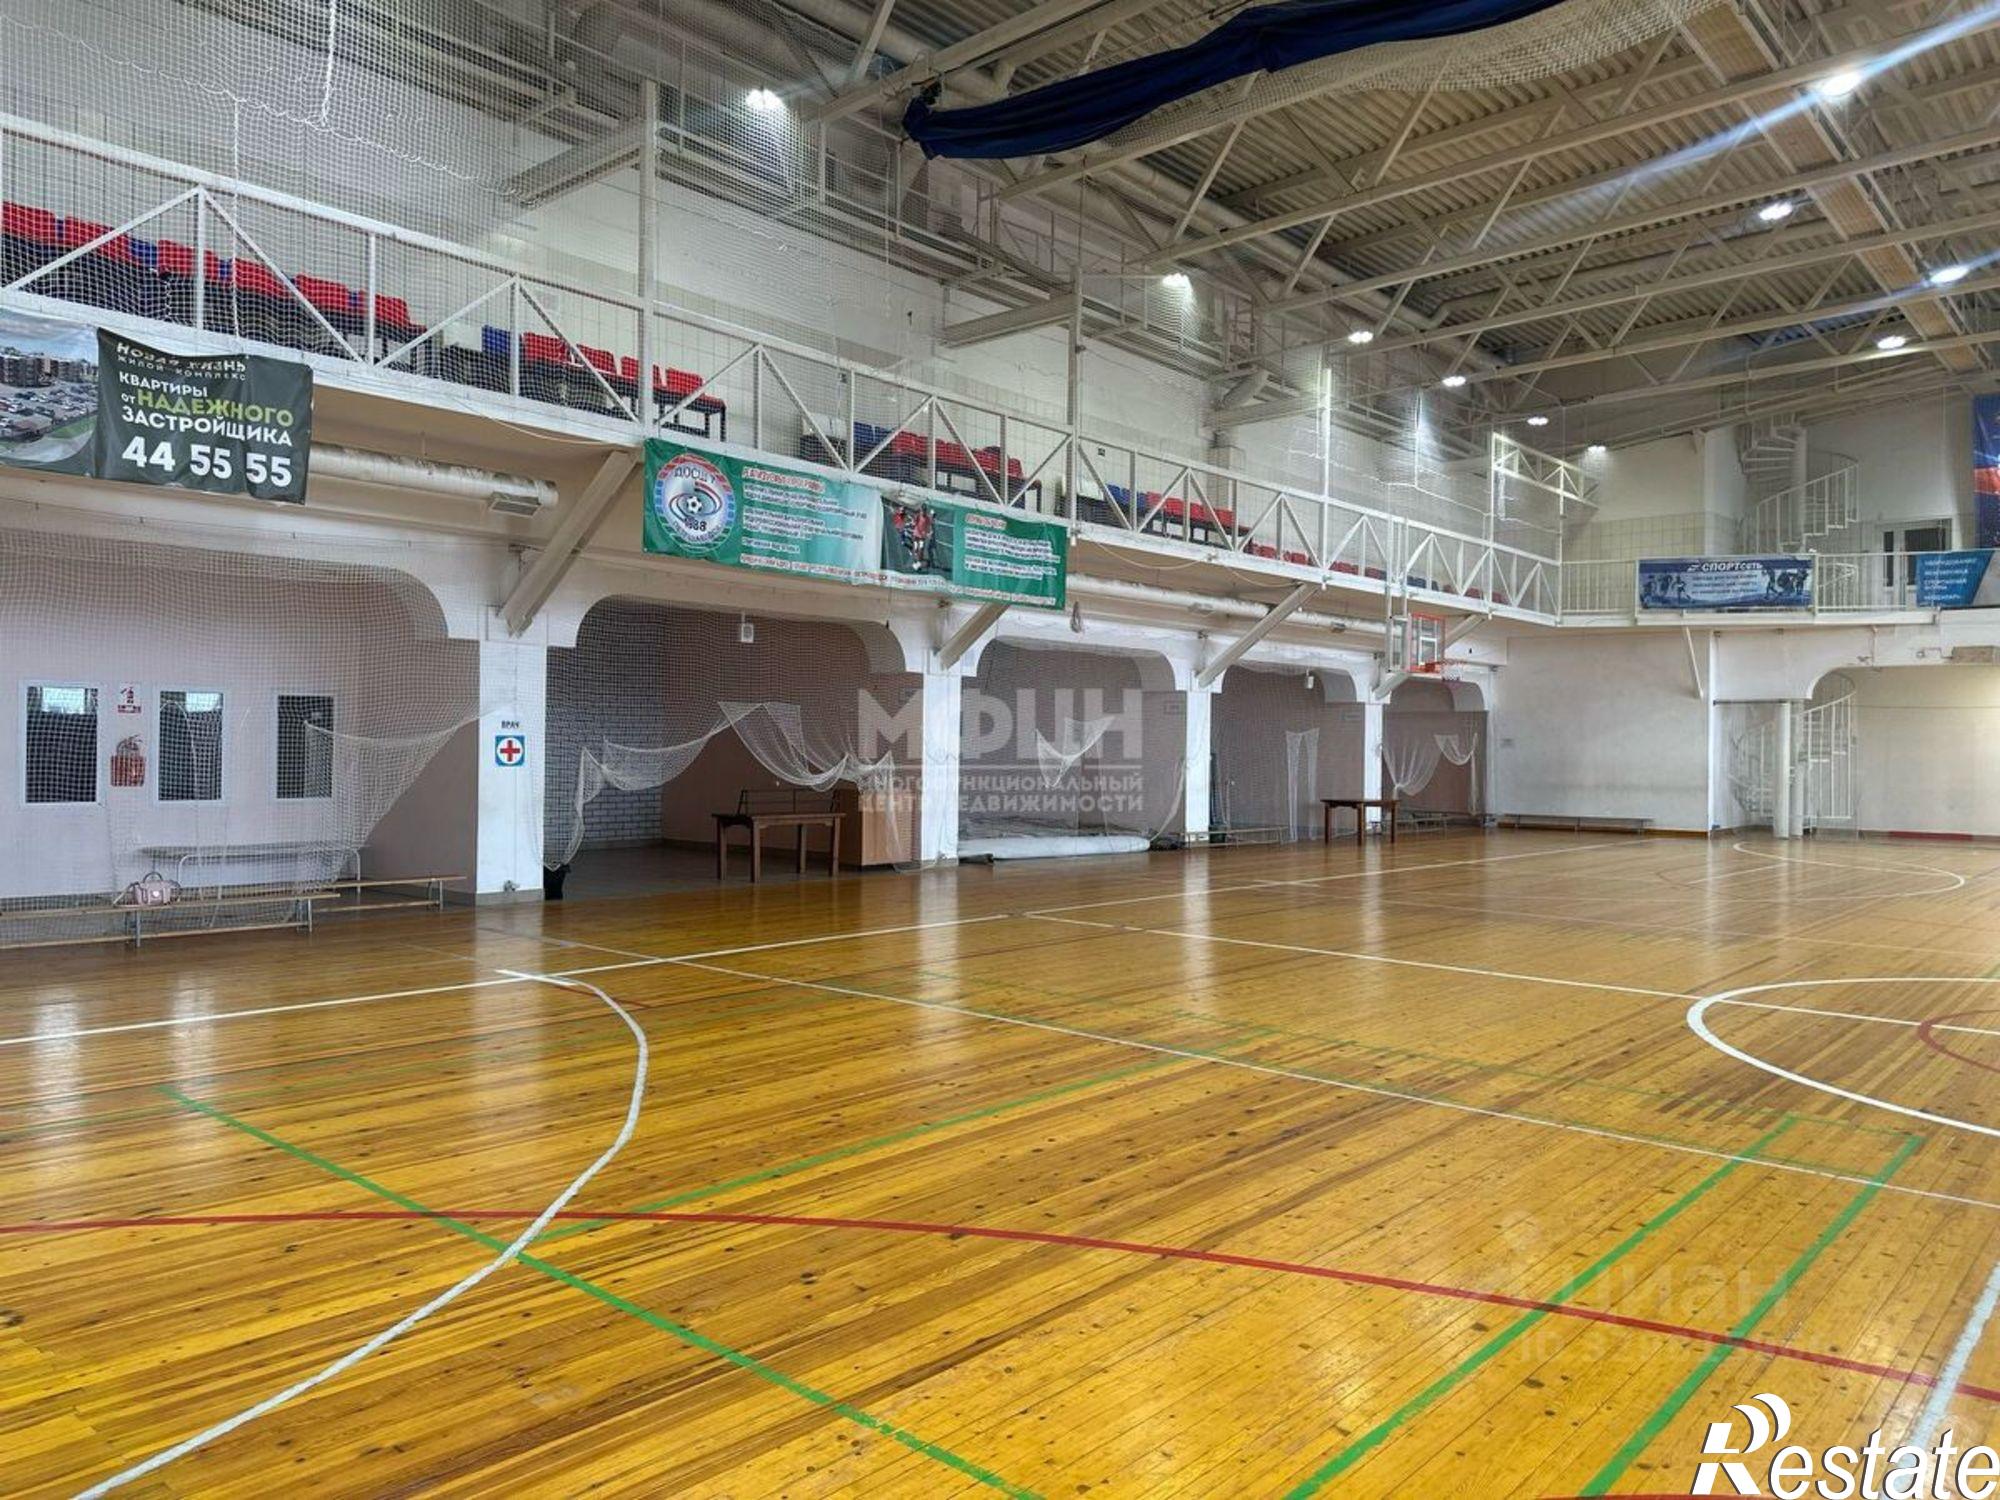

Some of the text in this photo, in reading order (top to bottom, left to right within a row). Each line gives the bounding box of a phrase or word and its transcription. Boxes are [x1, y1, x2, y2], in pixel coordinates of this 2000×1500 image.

[119, 371, 208, 397] КВАРТИРЫ
[121, 406, 293, 447] ЗАСТРОЙЩИКА
[137, 389, 294, 428] НАДЕЖНОГО
[121, 435, 293, 487] 44 55 55
